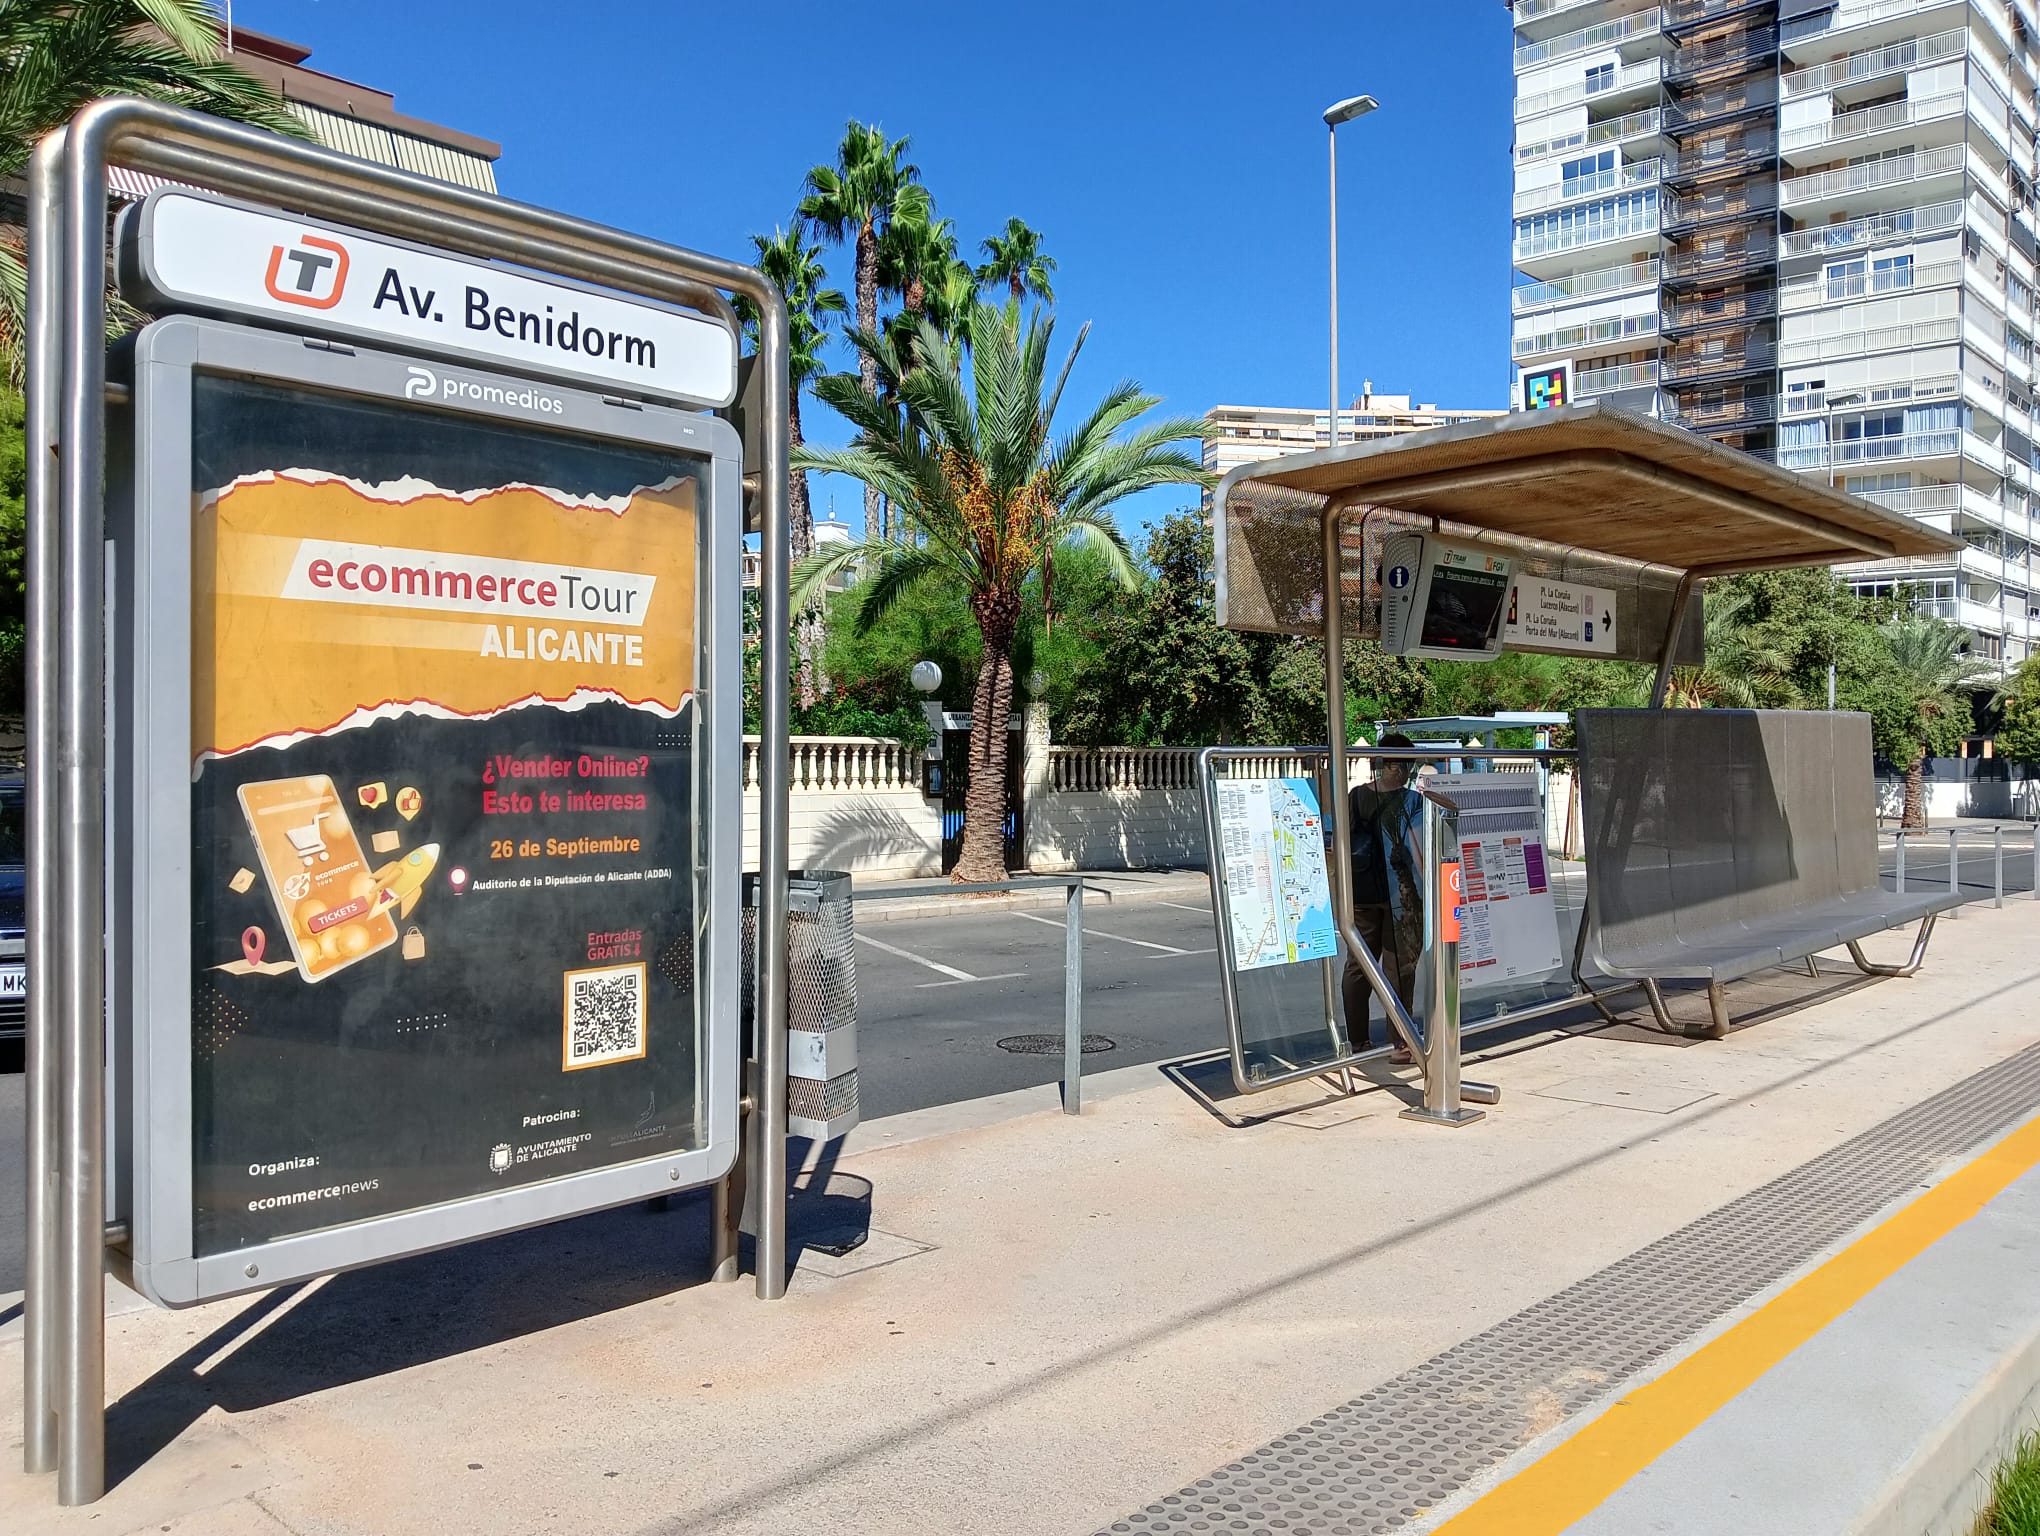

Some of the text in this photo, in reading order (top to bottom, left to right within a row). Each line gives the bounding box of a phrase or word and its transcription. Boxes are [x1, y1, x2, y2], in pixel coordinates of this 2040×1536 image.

[372, 267, 656, 369] Av. Benidorm
[443, 378, 563, 414] promedios
[308, 558, 637, 614] ecommerceTour
[480, 624, 644, 667] ALICANTE
[482, 754, 649, 785] ¿Vender Online?
[483, 789, 647, 815] Esto te interesa
[490, 835, 641, 859] 26 de Septiembre
[314, 860, 360, 882] ecommerce
[472, 868, 672, 891] Auditorio de la Diputación de Alicante (ADDA)
[318, 902, 358, 926] TICKETS
[588, 928, 642, 946] Entradas
[587, 944, 632, 961] GRATIS
[522, 1108, 581, 1128] Patrocina:
[516, 1133, 592, 1155] AYUNTAMIENTO
[516, 1144, 578, 1164] DE ALICANTE
[248, 1155, 320, 1176] Organiza:
[248, 1178, 380, 1212] ecommercenews
